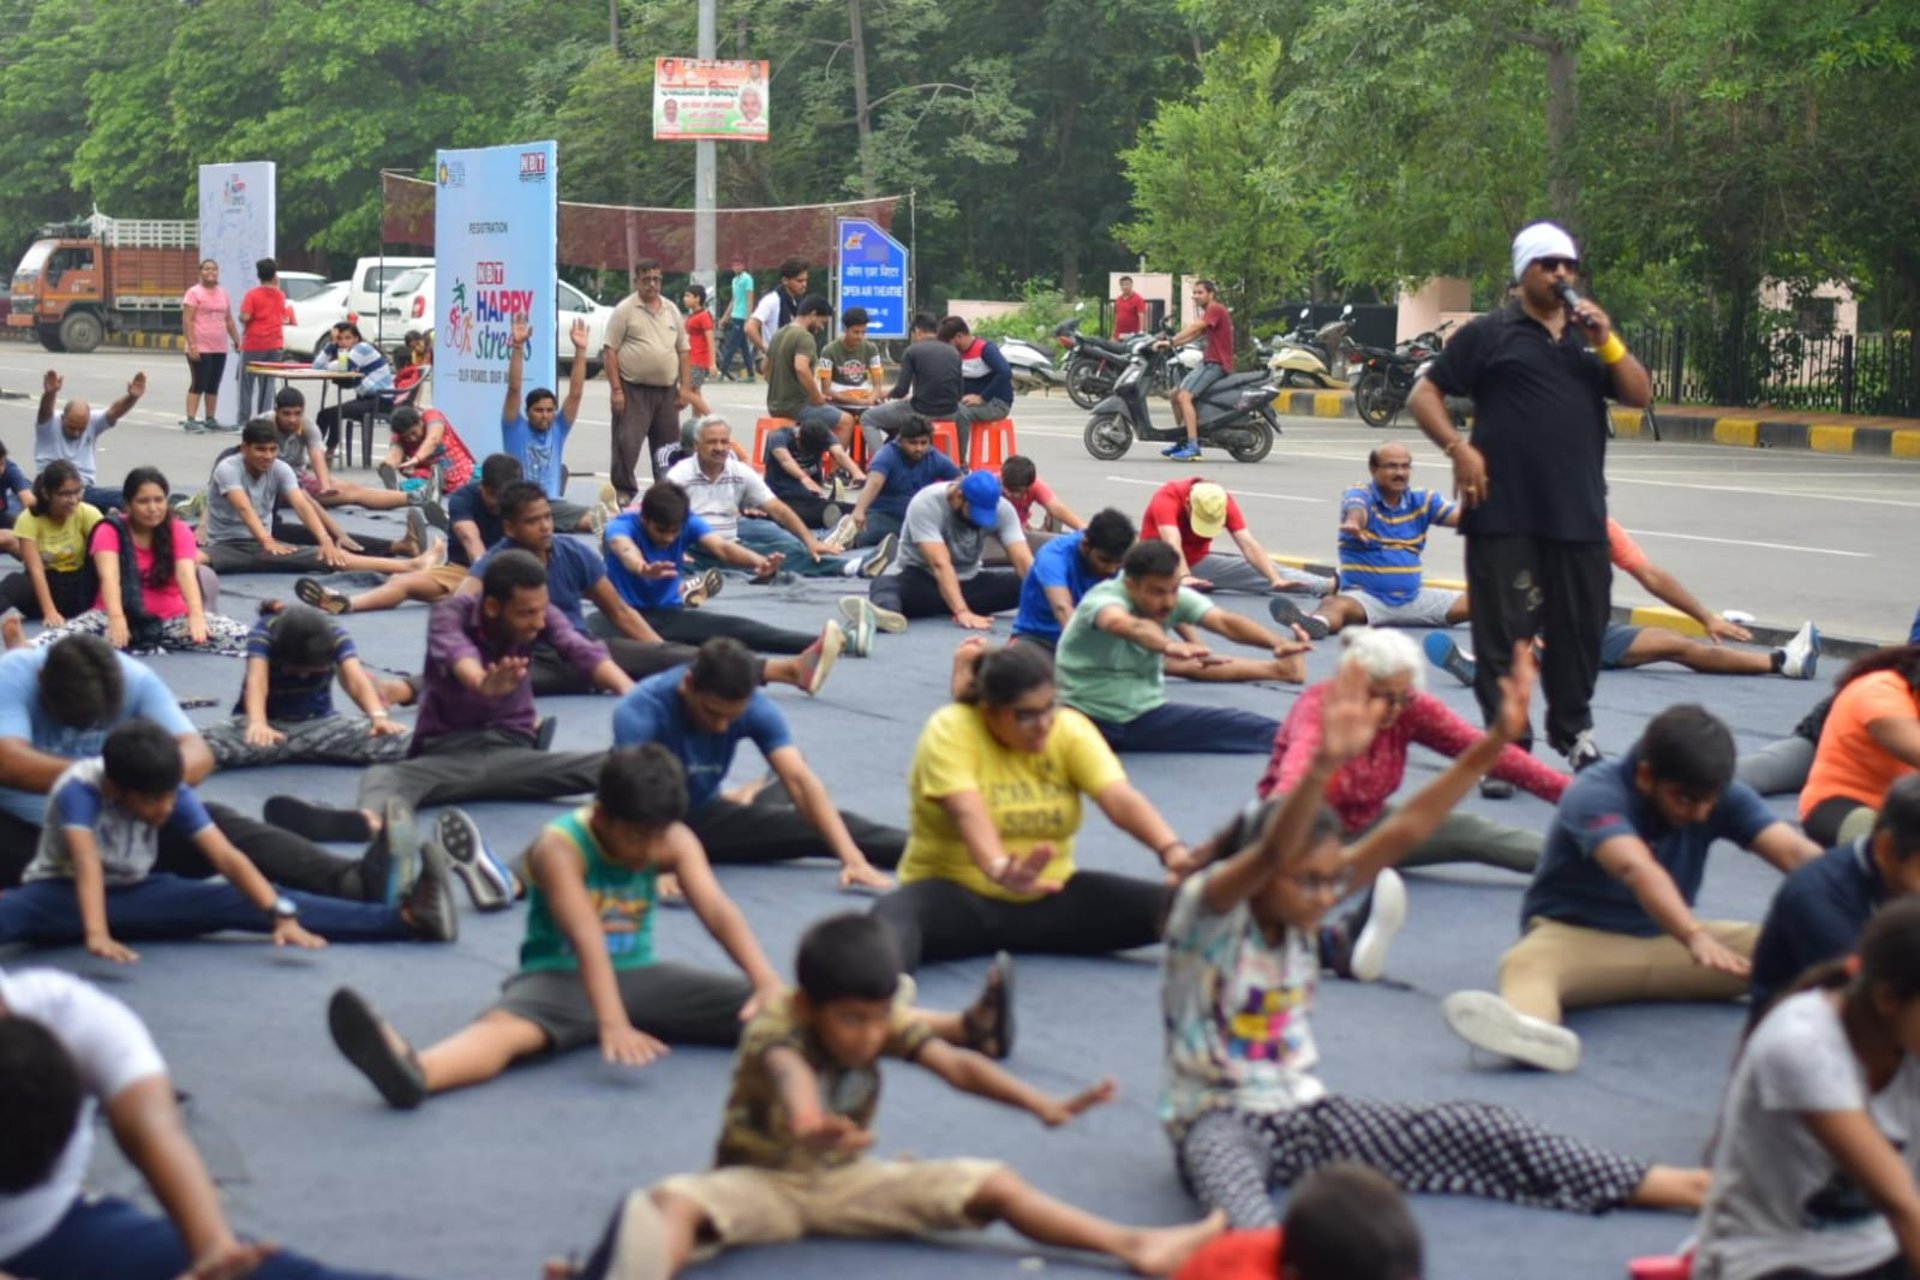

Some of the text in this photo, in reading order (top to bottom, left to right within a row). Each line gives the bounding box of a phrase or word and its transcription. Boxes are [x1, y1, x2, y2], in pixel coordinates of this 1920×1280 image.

[520, 153, 545, 173] NBT
[468, 222, 508, 234] REGISTRATION
[477, 262, 504, 285] NBT
[842, 286, 903, 298] OPEN AIR THEATRE
[476, 290, 533, 322] HAPPY
